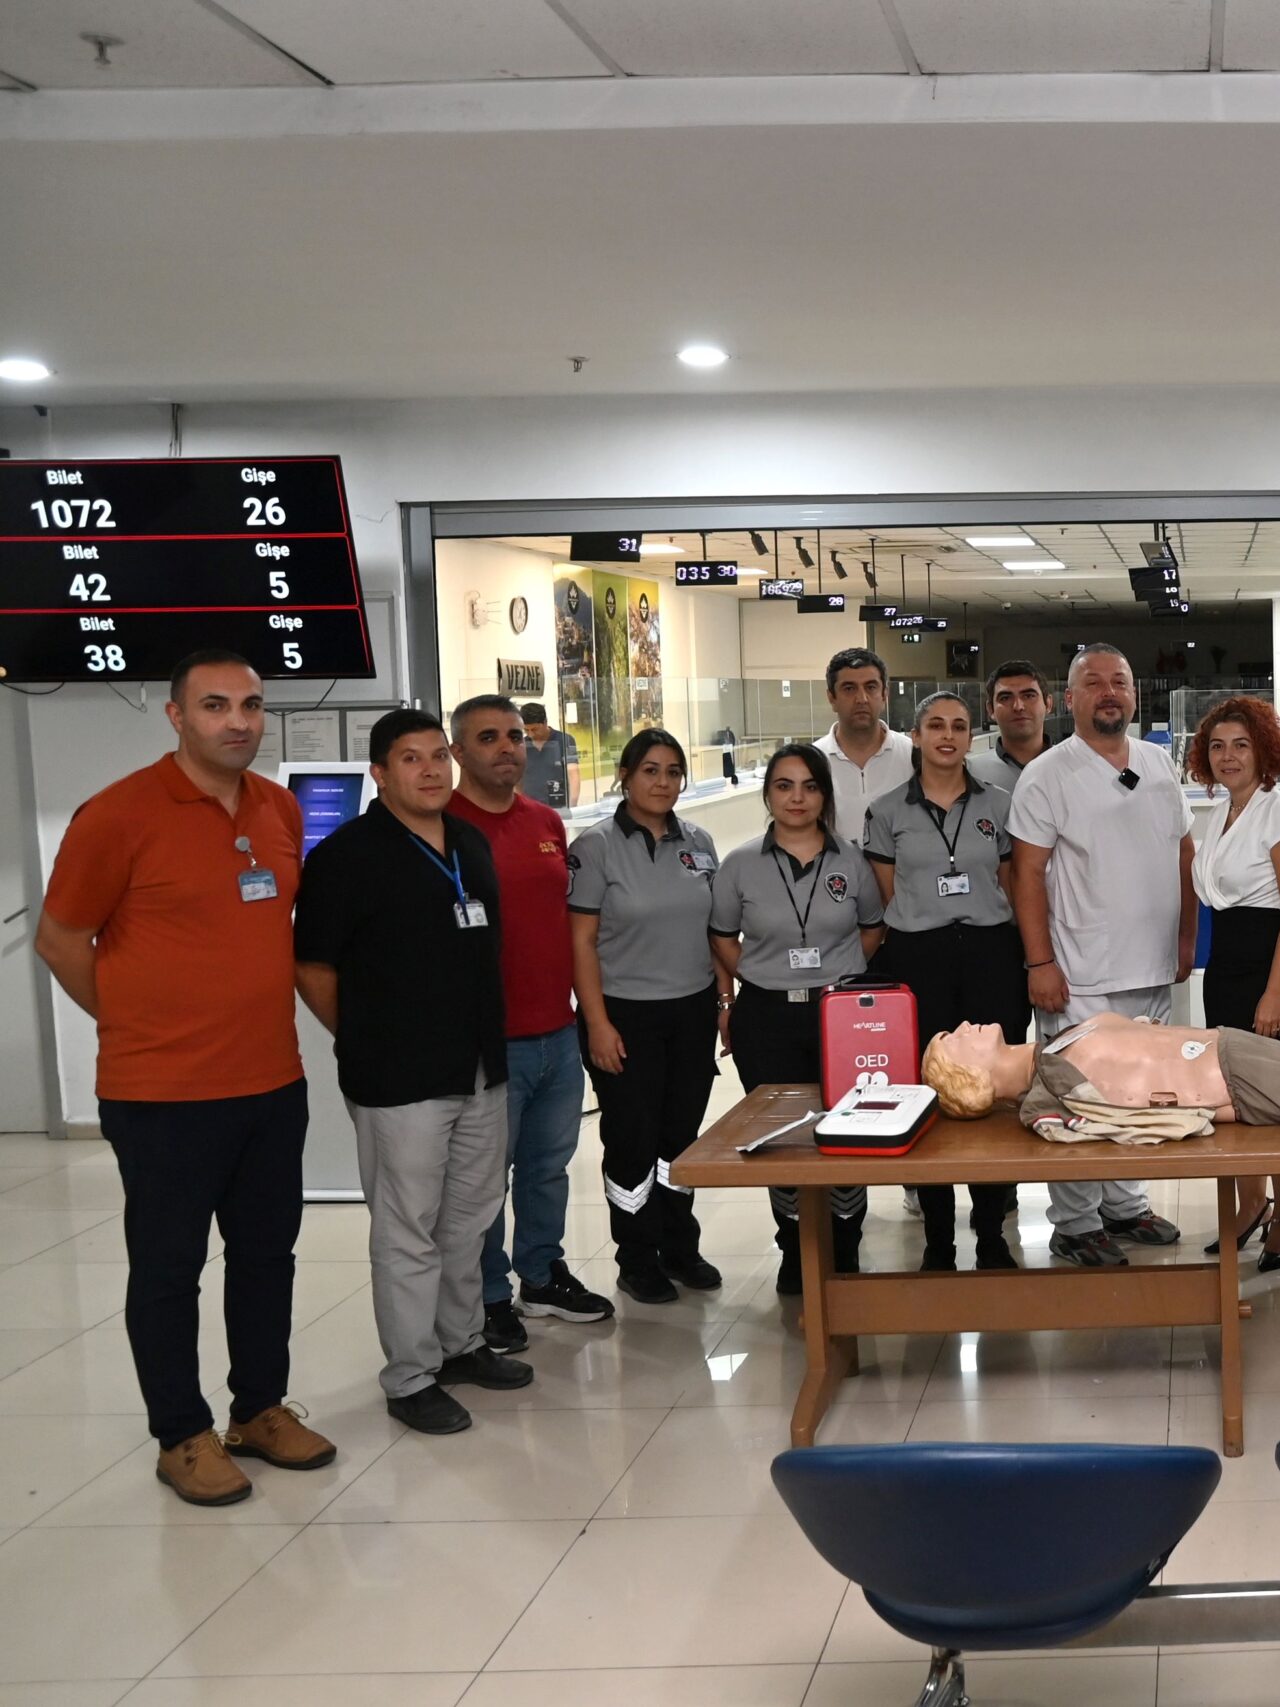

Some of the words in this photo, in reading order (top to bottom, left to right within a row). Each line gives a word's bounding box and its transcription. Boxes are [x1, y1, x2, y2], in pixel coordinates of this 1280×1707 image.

[46, 469, 84, 486] Bilet
[240, 467, 276, 487] Gişe
[30, 499, 116, 529] 1072
[242, 496, 286, 527] 26
[62, 544, 99, 561] Bilet
[255, 541, 290, 561] Gişe
[618, 537, 638, 552] 31
[676, 566, 710, 580] 035
[717, 565, 737, 577] 30
[1162, 569, 1177, 580] 17
[68, 573, 111, 602] 42
[269, 571, 290, 600] 5
[883, 607, 897, 616] 27
[79, 616, 116, 632] Bilet
[268, 613, 304, 633] Gişe
[83, 644, 126, 672] 38
[282, 642, 303, 670] 5
[506, 664, 542, 692] VEZNE
[855, 1054, 889, 1068] OED
